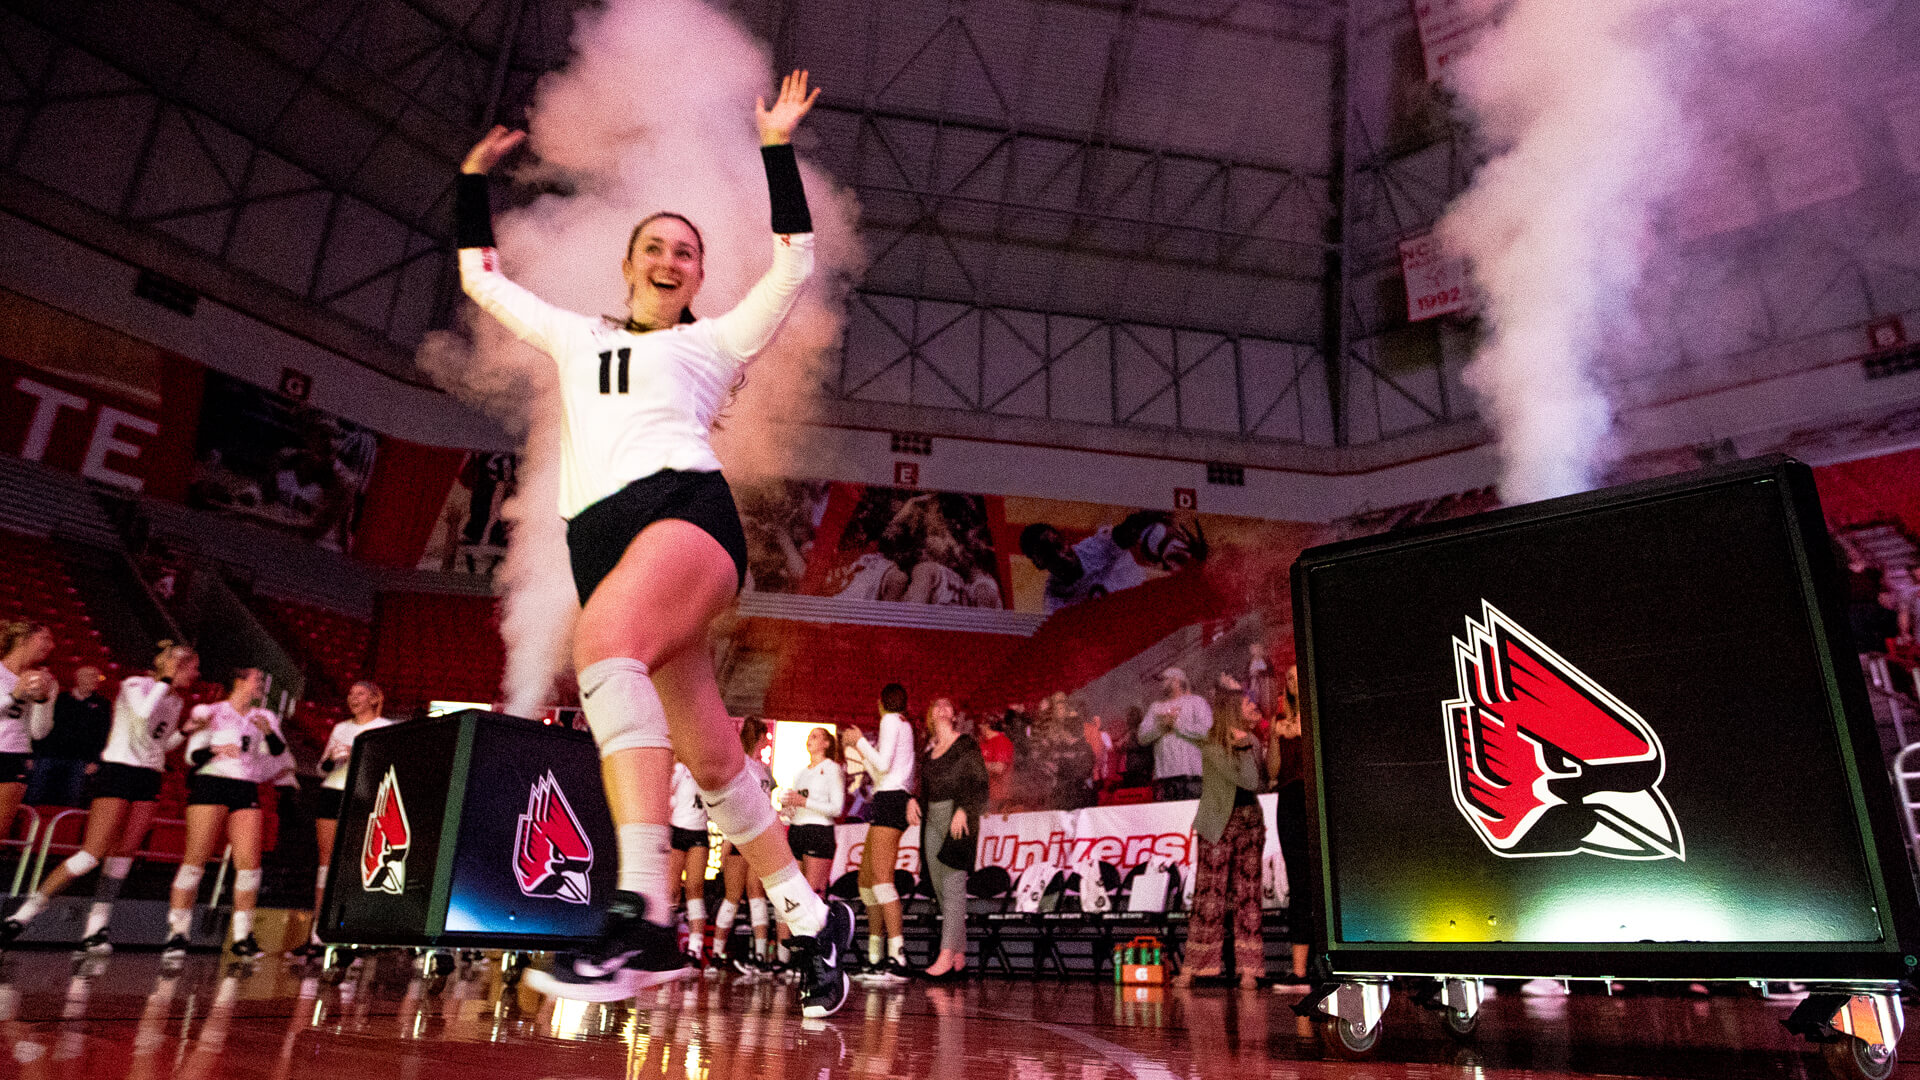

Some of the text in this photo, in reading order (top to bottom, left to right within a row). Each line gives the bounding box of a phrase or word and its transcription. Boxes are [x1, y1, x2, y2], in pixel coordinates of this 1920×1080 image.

[1417, 286, 1460, 310] 1992
[599, 347, 632, 395] 11
[15, 377, 160, 493] TE
[900, 468, 913, 483] E
[1178, 494, 1192, 508] D
